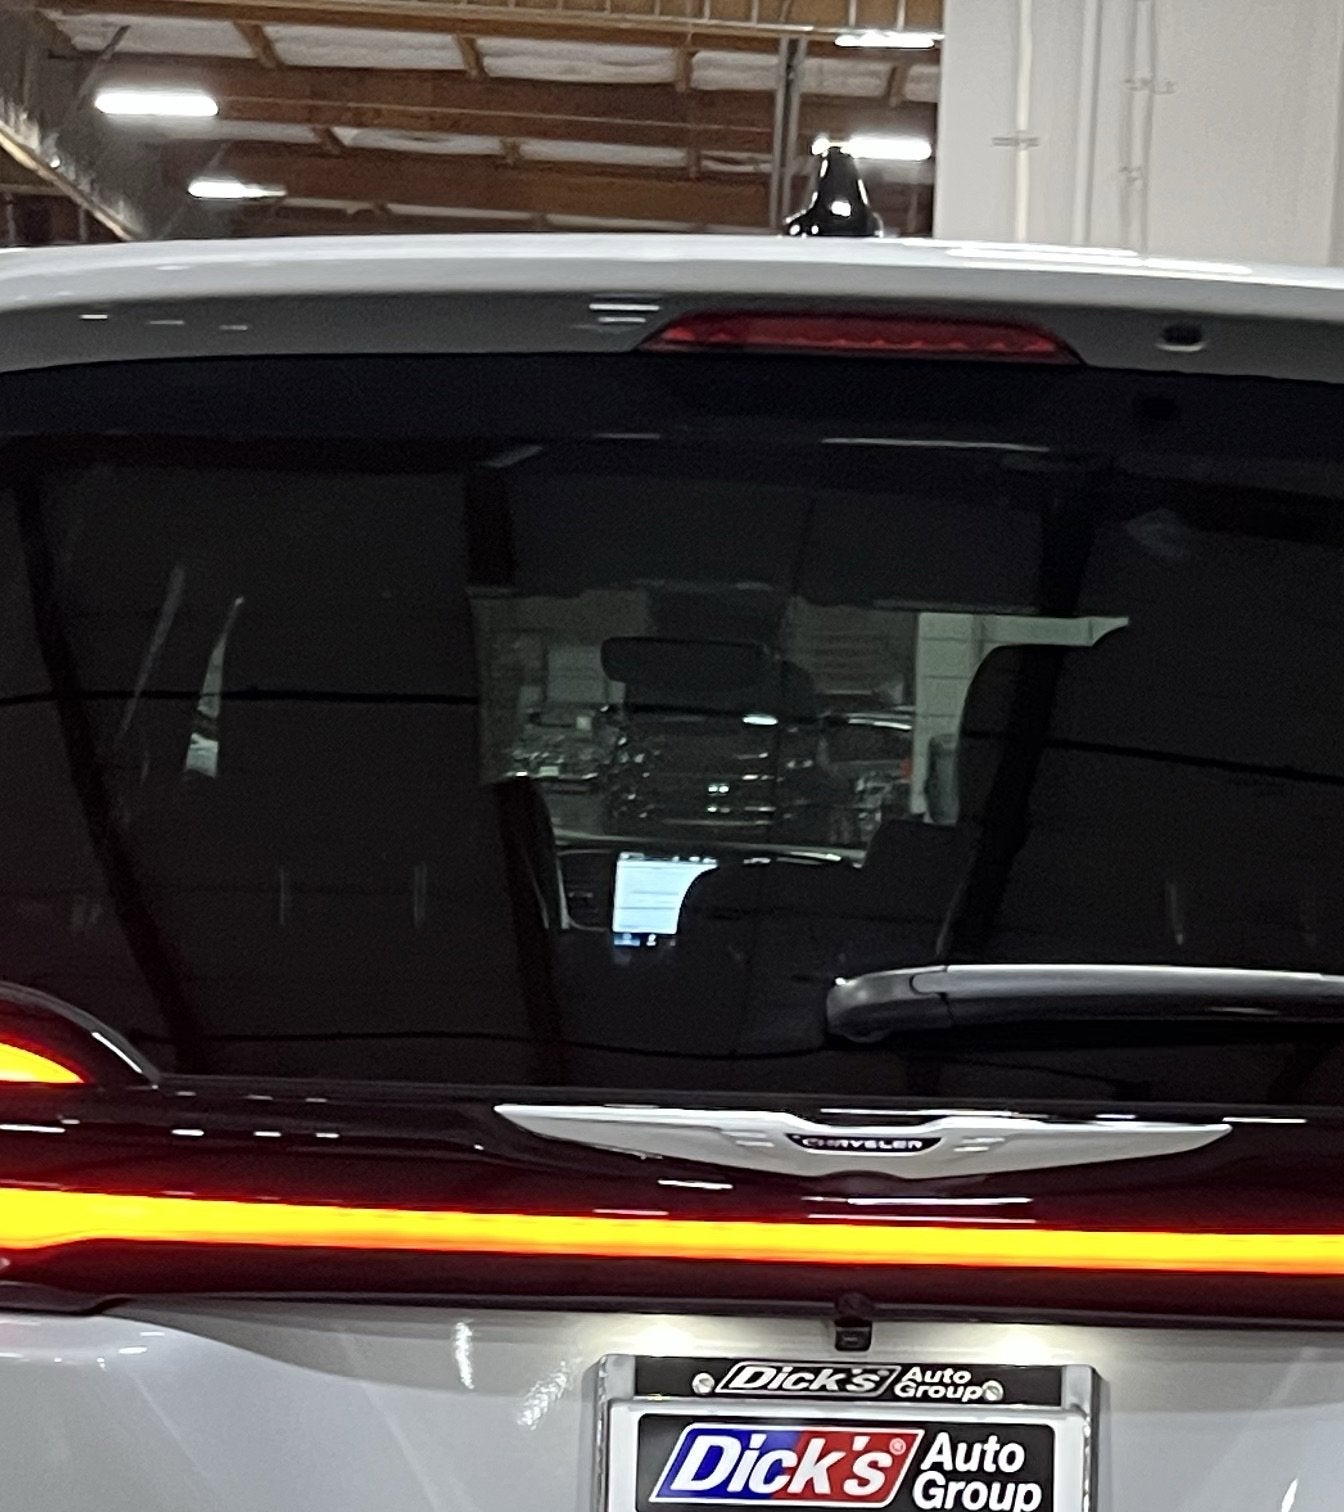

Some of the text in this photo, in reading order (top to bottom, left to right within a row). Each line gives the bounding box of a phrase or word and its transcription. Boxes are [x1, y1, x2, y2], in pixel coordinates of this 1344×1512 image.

[728, 1366, 972, 1392] Dick's Auto
[894, 1380, 984, 1402] Group
[670, 1431, 1026, 1497] Dick's Auto
